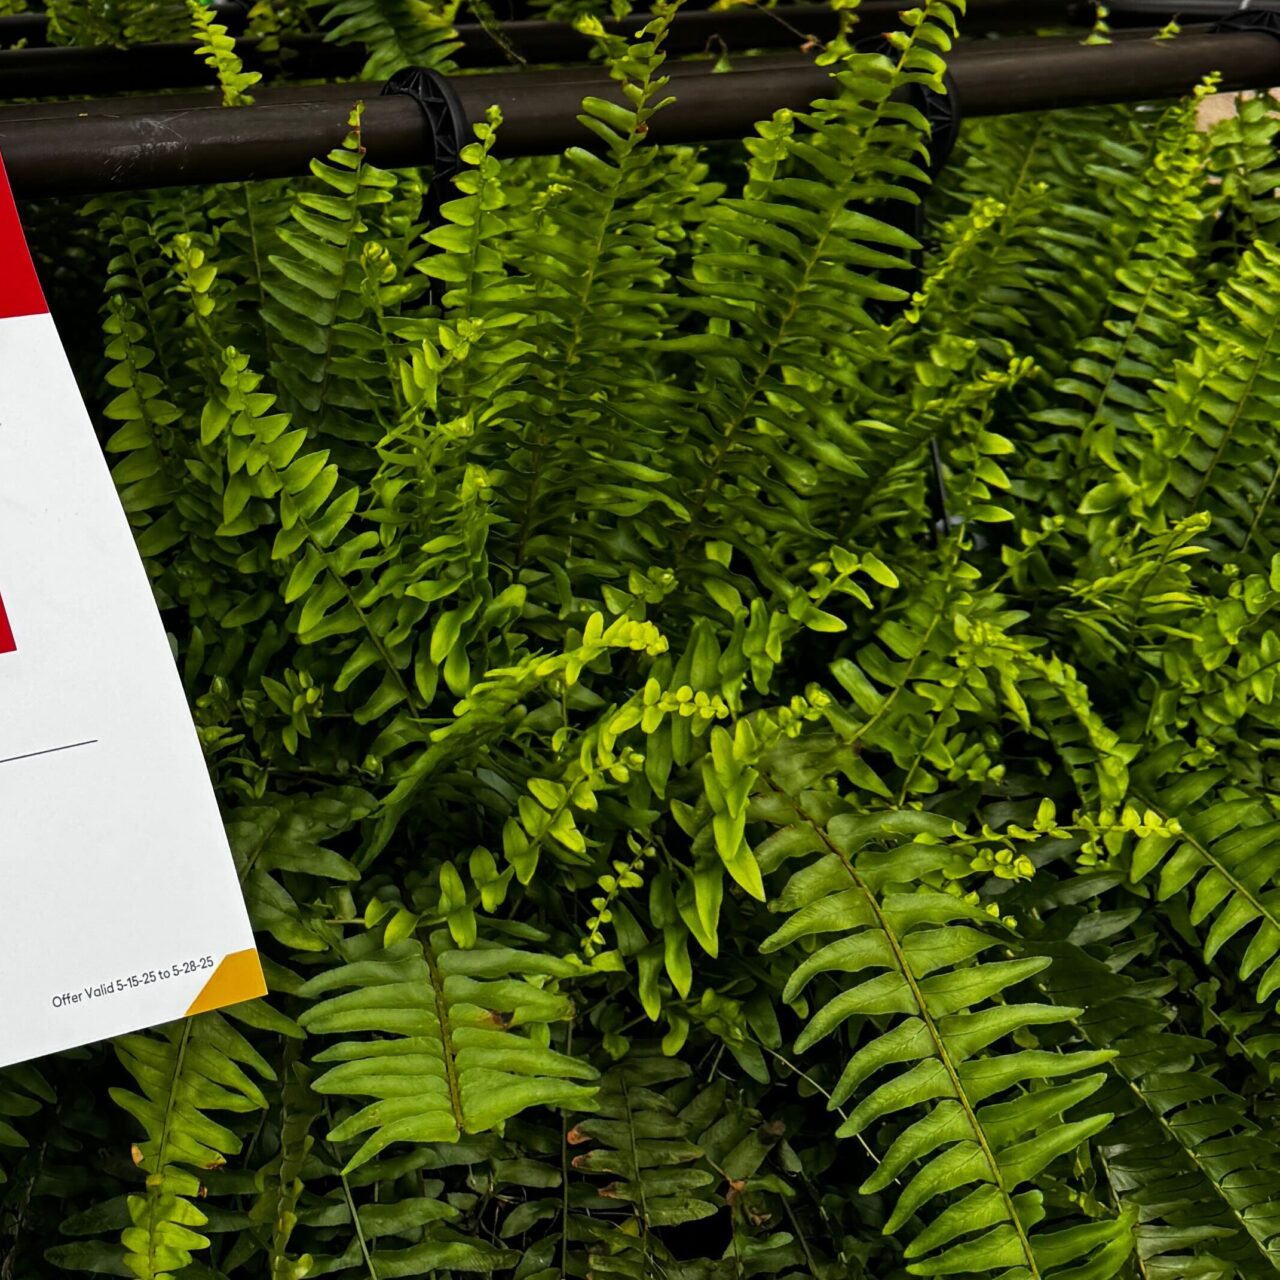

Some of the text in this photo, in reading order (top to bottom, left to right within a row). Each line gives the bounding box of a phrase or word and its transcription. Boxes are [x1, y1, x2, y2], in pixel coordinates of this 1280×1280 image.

[51, 955, 214, 1008] Offer Valid 5-15-25 to 5-28-25
